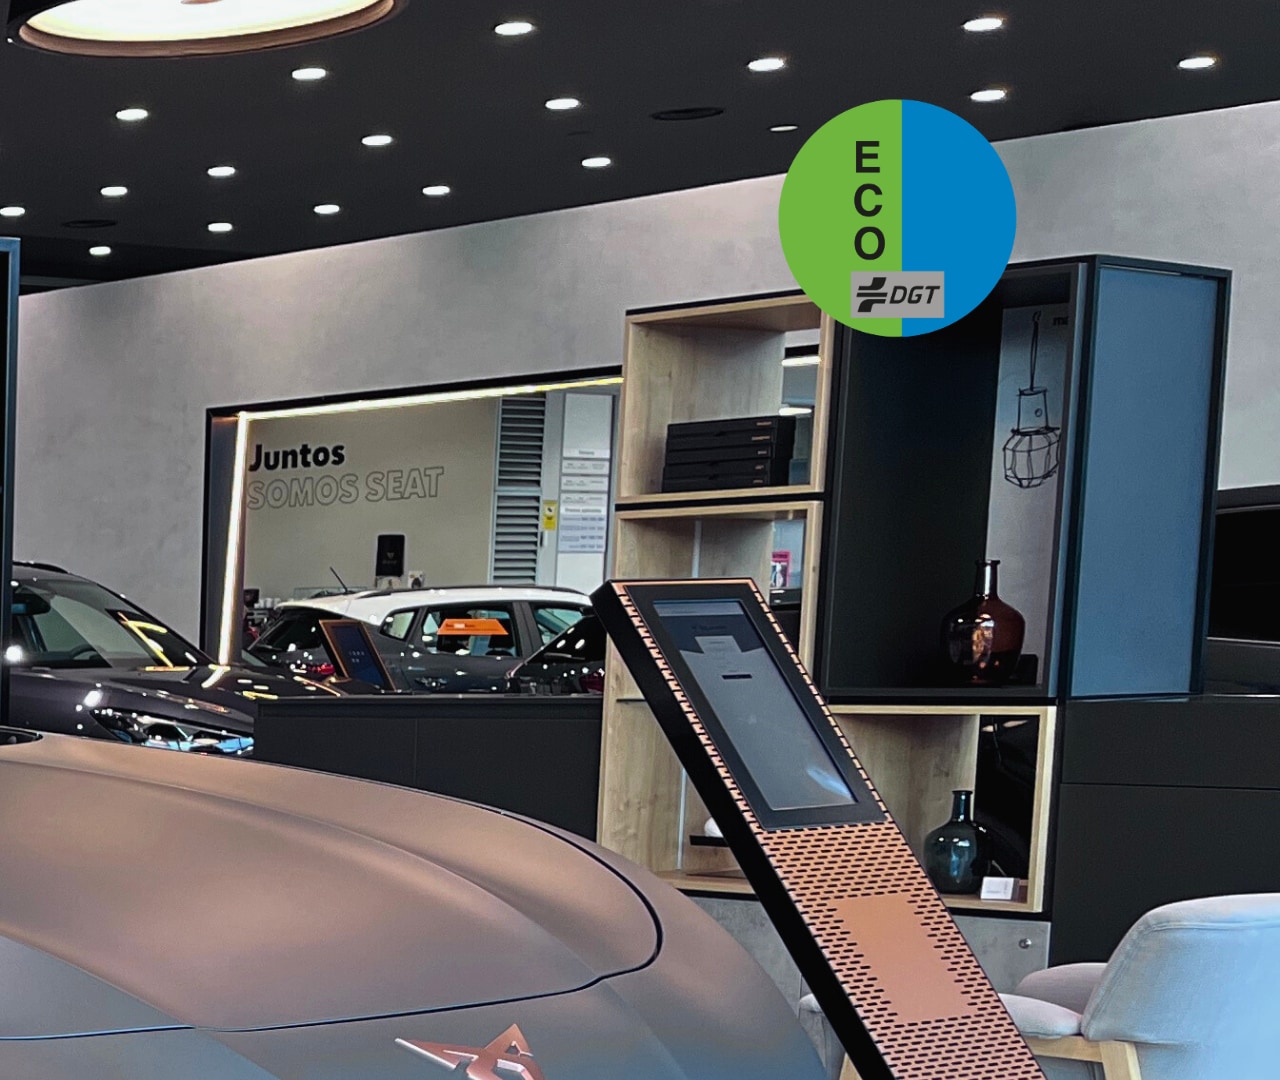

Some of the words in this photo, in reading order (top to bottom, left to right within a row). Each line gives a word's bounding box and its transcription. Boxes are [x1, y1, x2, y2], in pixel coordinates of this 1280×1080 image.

[248, 443, 346, 472] Juntos
[247, 474, 360, 511] SOMOS
[365, 466, 445, 503] SEAT
